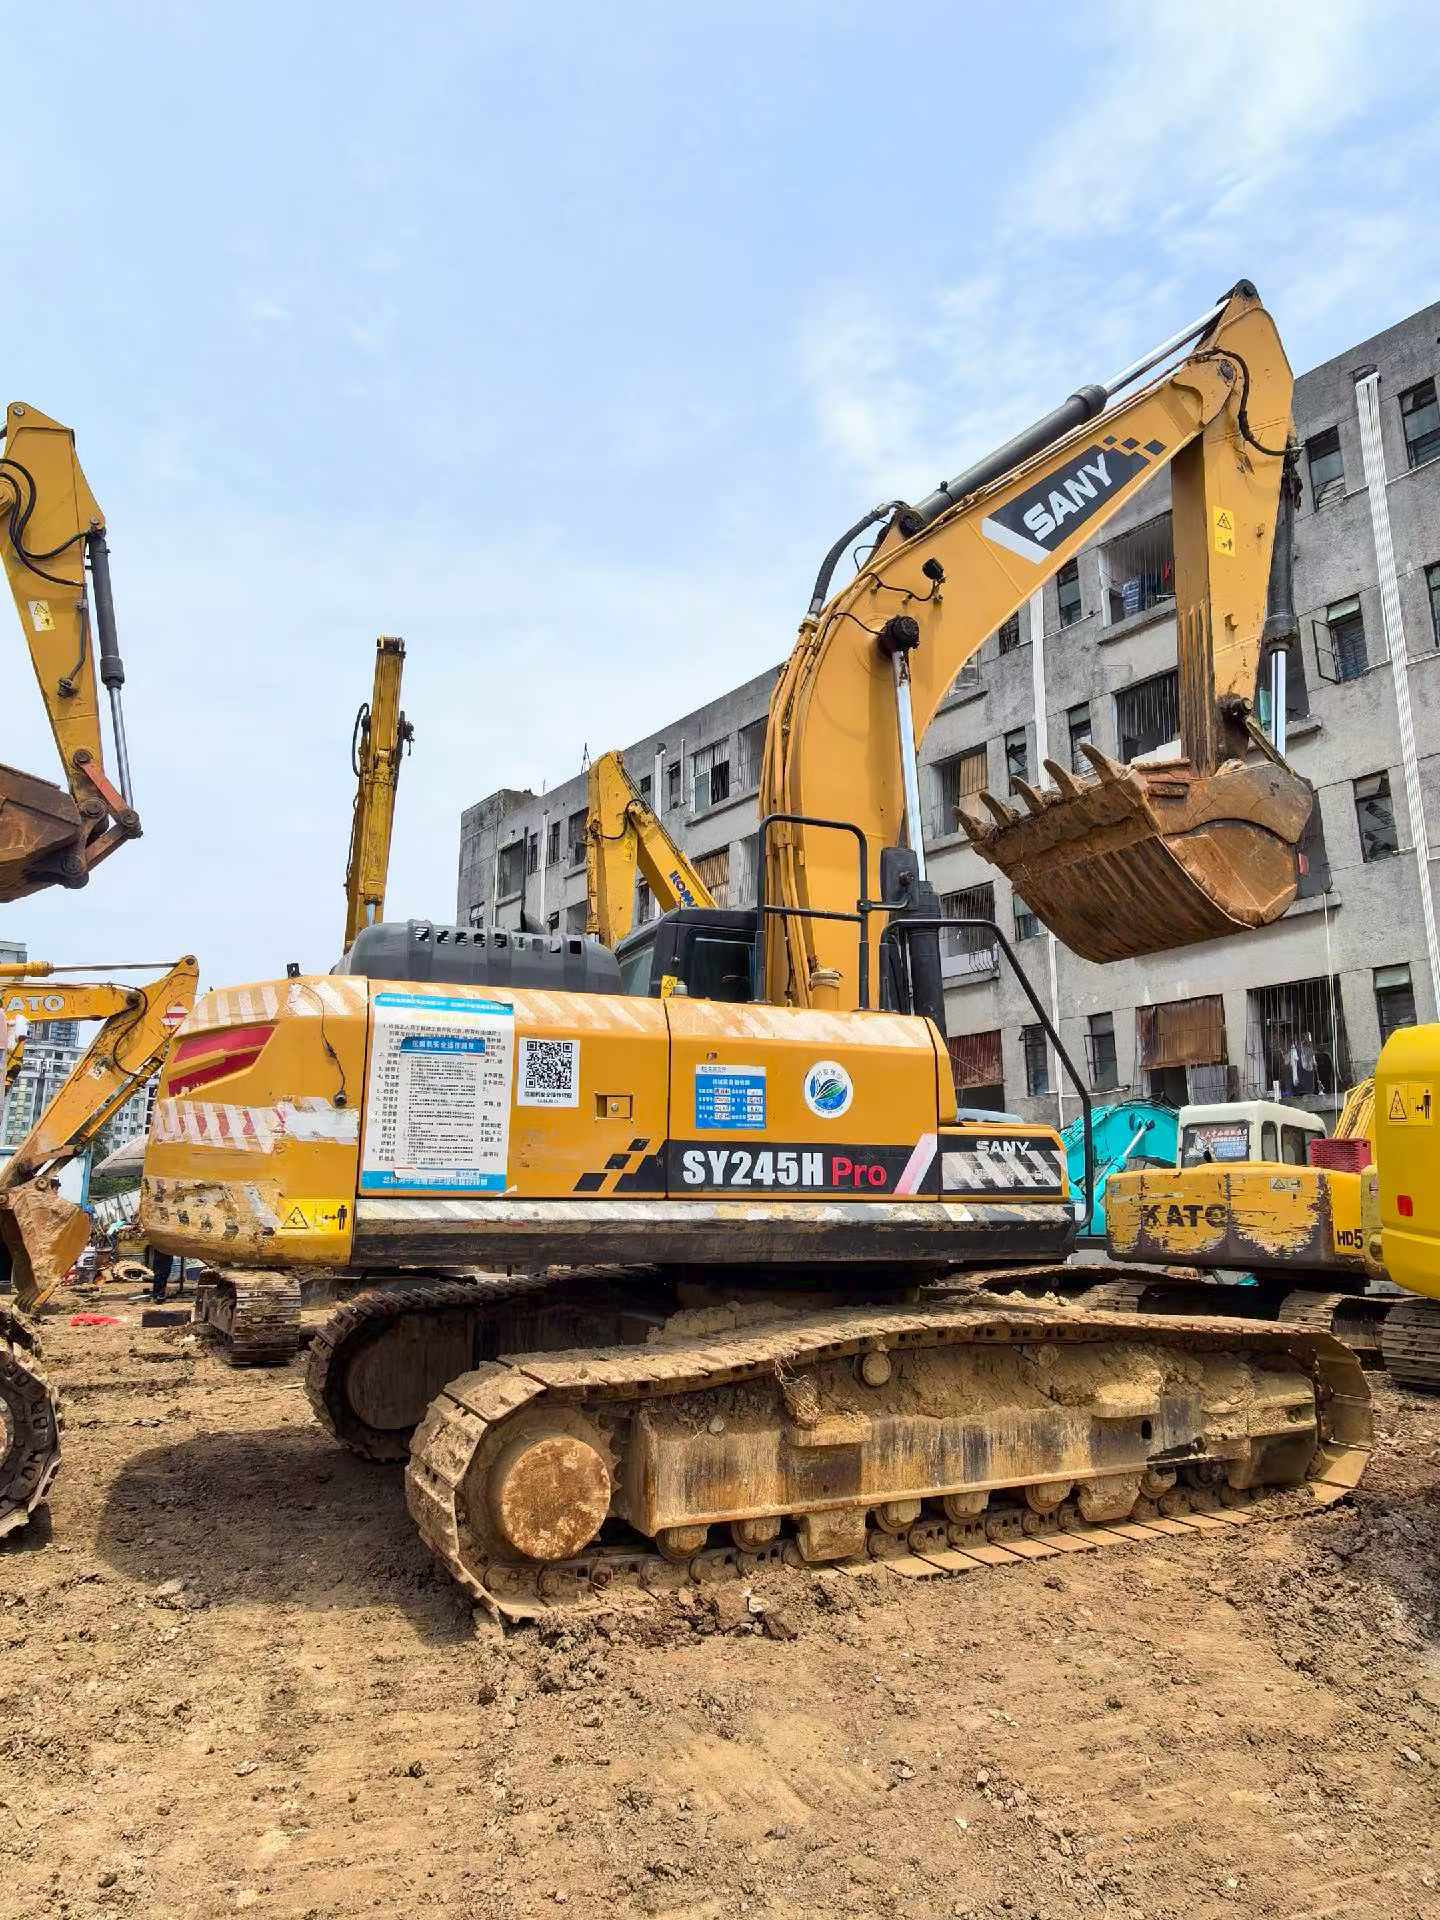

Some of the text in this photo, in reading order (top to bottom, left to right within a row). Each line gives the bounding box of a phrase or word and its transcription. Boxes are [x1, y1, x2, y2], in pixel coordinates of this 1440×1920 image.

[1023, 453, 1113, 542] SANY
[670, 871, 696, 907] KOM
[6, 995, 65, 1011] ATO
[976, 1140, 1030, 1156] SANY
[682, 1149, 887, 1187] SY245H Pro
[1141, 1204, 1227, 1228] KATO
